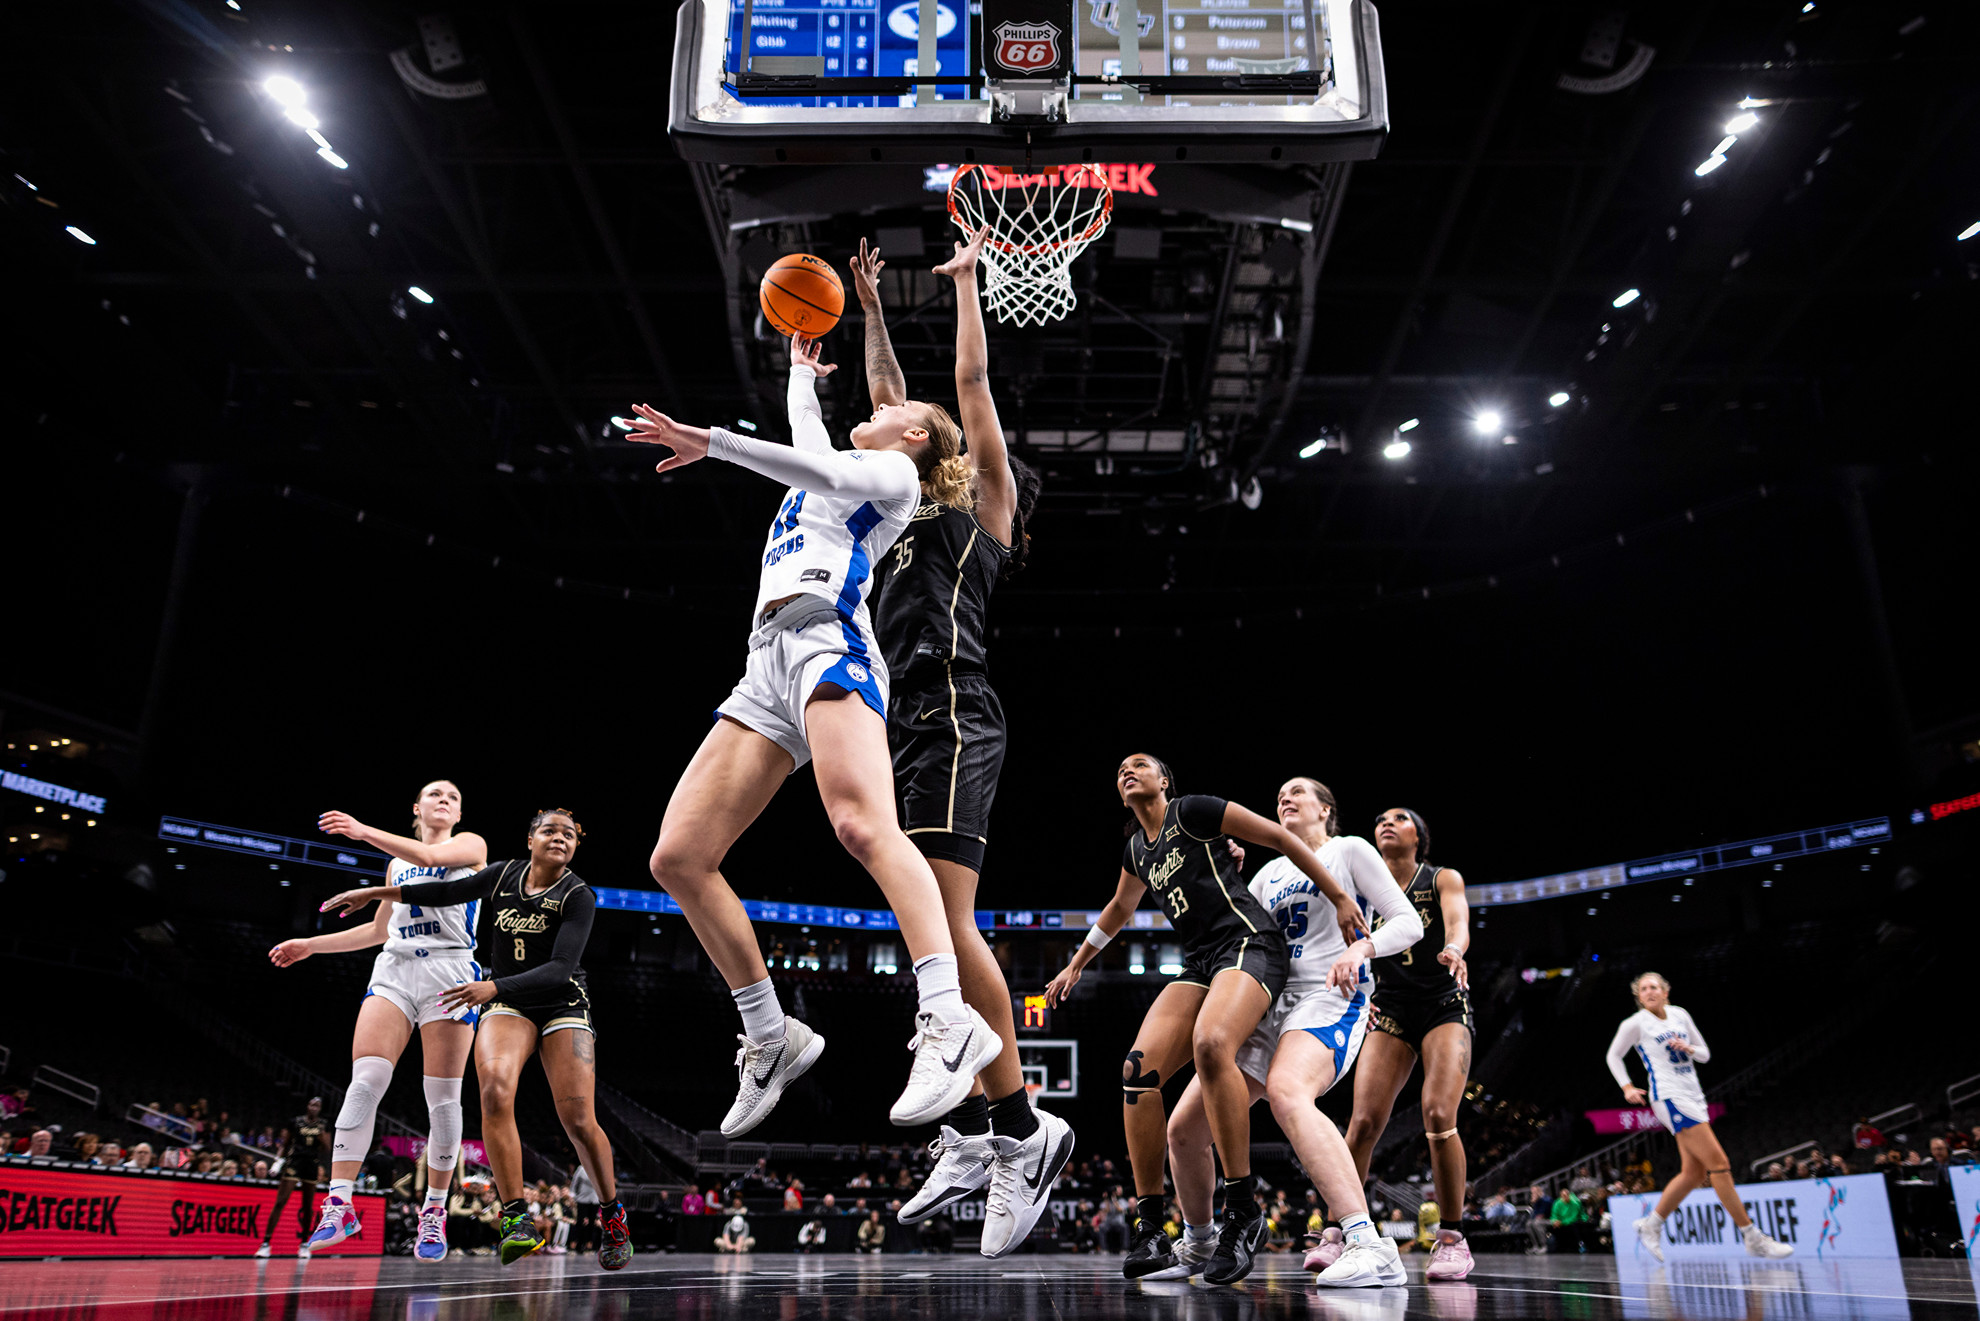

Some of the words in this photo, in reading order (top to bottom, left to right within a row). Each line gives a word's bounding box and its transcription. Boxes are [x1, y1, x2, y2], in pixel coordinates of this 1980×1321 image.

[1004, 29, 1051, 39] PHILLIPS
[1007, 44, 1047, 62] 66
[982, 163, 1159, 197] SEATGEEK
[893, 536, 915, 576] 35
[1, 771, 107, 814] MARKETPLACE
[1148, 847, 1186, 891] Knights
[1168, 887, 1190, 919] 33
[398, 921, 442, 939] YOUNG
[494, 908, 550, 935] Knights
[514, 938, 525, 961] 8
[0, 1189, 122, 1236] SEATGEEK
[169, 1200, 261, 1239] SEATGEEK
[1665, 1204, 1726, 1245] CRAMP
